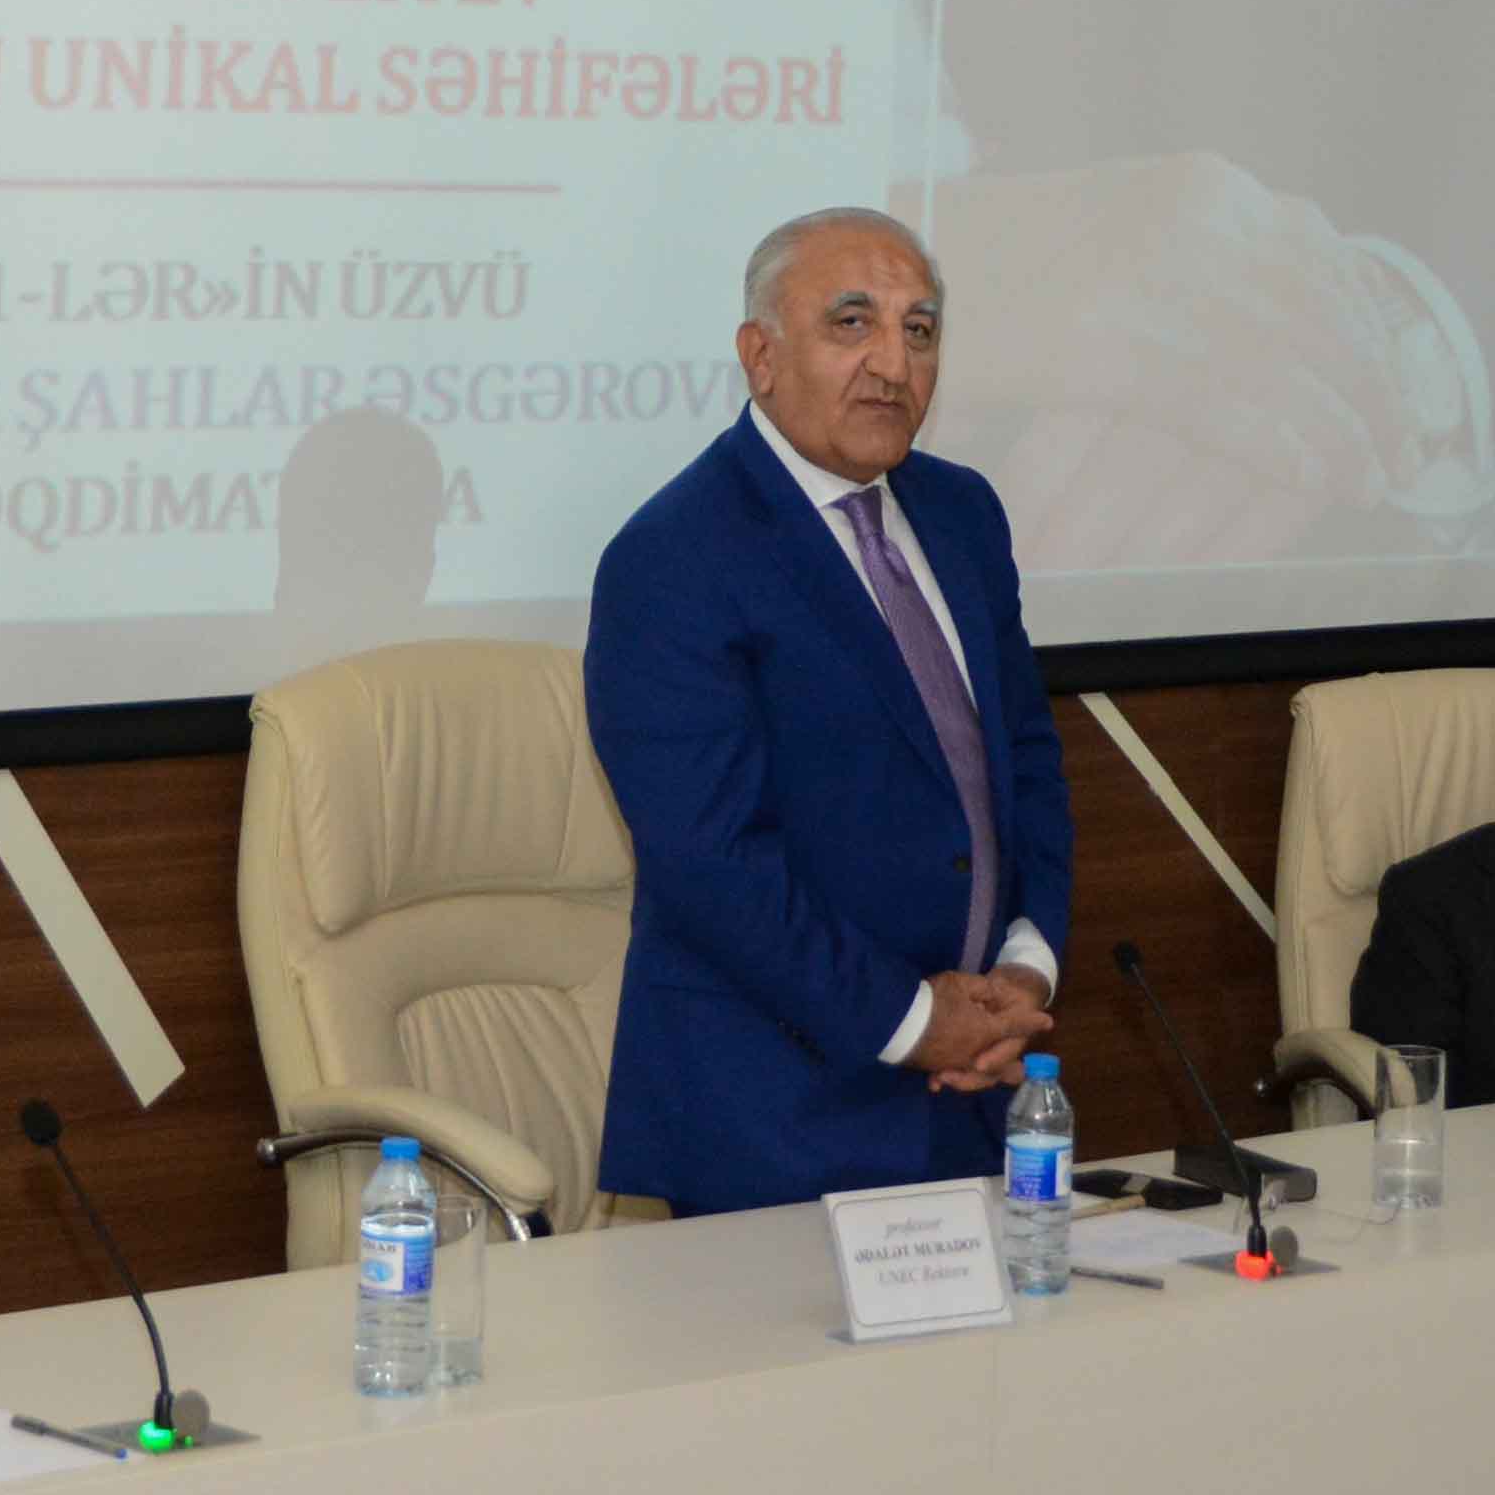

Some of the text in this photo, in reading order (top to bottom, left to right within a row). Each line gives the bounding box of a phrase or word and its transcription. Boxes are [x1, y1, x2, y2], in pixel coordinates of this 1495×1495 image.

[27, 24, 361, 113] UNİKAL
[376, 36, 846, 126] SƏHİFƏLƏRİ
[338, 251, 531, 321] ÜZVÜ
[17, 363, 346, 453] ŞAHLAR
